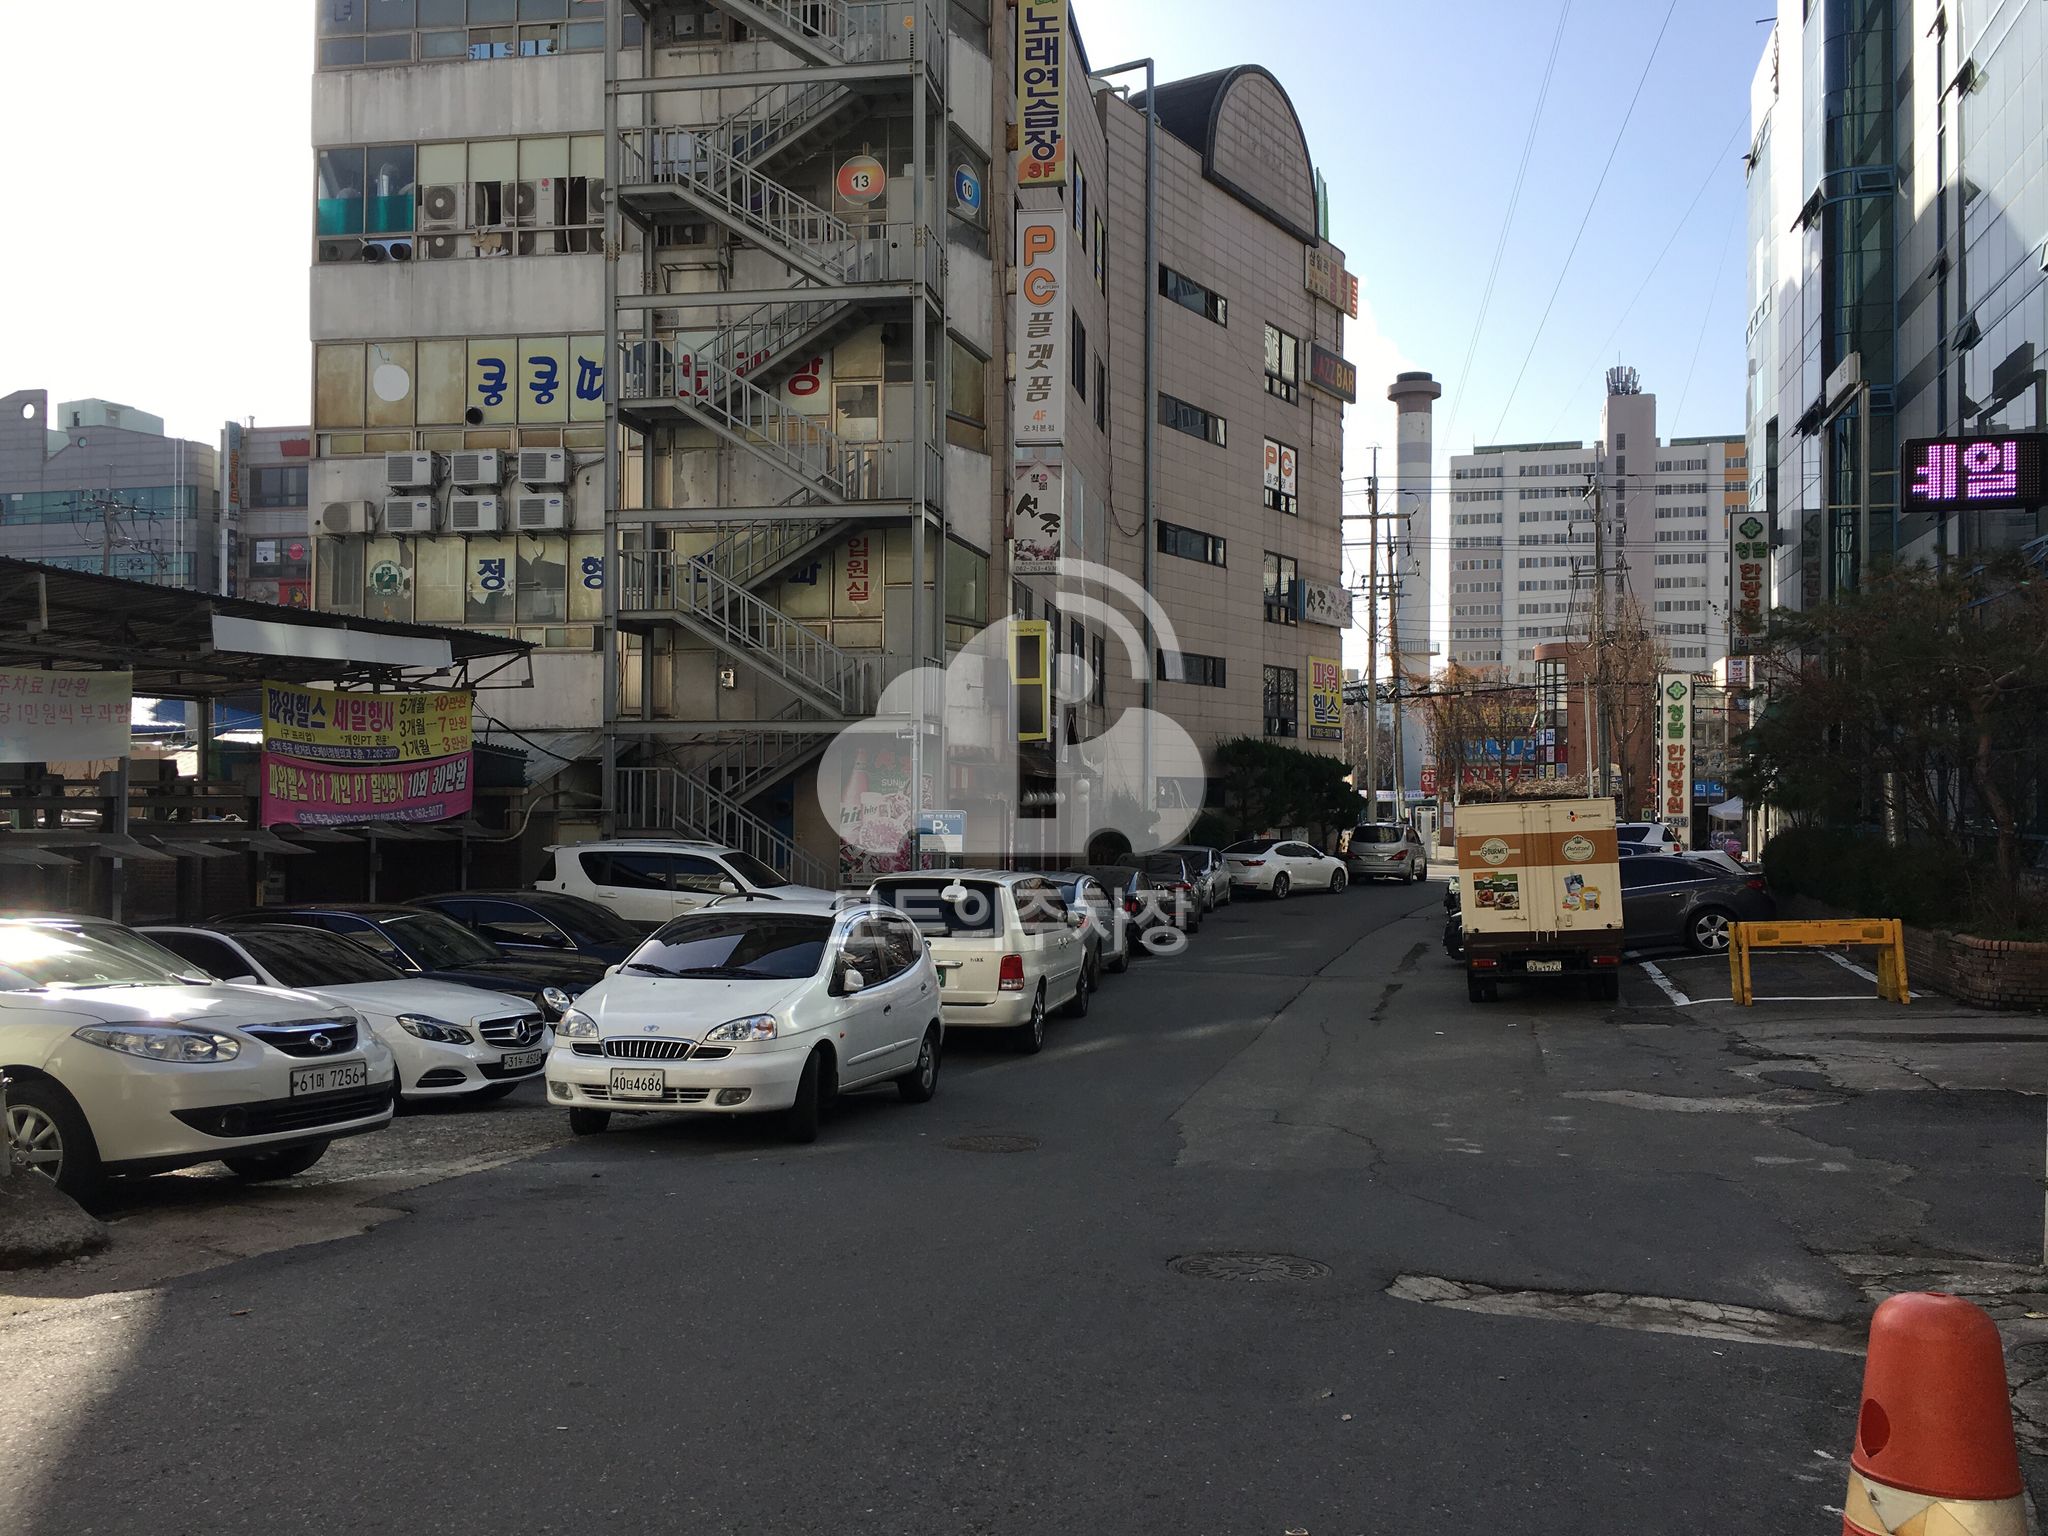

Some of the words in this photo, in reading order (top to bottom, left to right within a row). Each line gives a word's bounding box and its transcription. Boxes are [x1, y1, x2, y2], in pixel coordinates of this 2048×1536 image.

[1024, 8, 1061, 161] 노래연습장
[852, 175, 869, 188] 13
[1028, 163, 1055, 178] 3F
[964, 182, 973, 198] 10
[1025, 311, 1054, 402] 플랫폼
[1312, 351, 1335, 387] JAZZ
[1336, 362, 1355, 395] BAR
[1032, 409, 1047, 423] 4F
[1735, 541, 1768, 559] 청담
[845, 536, 869, 603] 입원실
[51, 678, 90, 697] 1만원
[1312, 662, 1340, 694] 파워
[267, 688, 327, 729] 파워헬스
[332, 697, 394, 733] 세일행사
[1312, 693, 1340, 724] 헬스
[1668, 704, 1686, 738] 청담
[400, 718, 426, 737] 3개월
[402, 738, 431, 756] 1개월
[269, 764, 308, 801] 파워헬스
[330, 773, 351, 804] 개인
[354, 772, 367, 802] PT
[407, 769, 428, 798] 10회
[431, 757, 468, 795] 30만원
[1667, 744, 1686, 814] 한방병원
[932, 820, 944, 834] P
[330, 1067, 360, 1088] 7256
